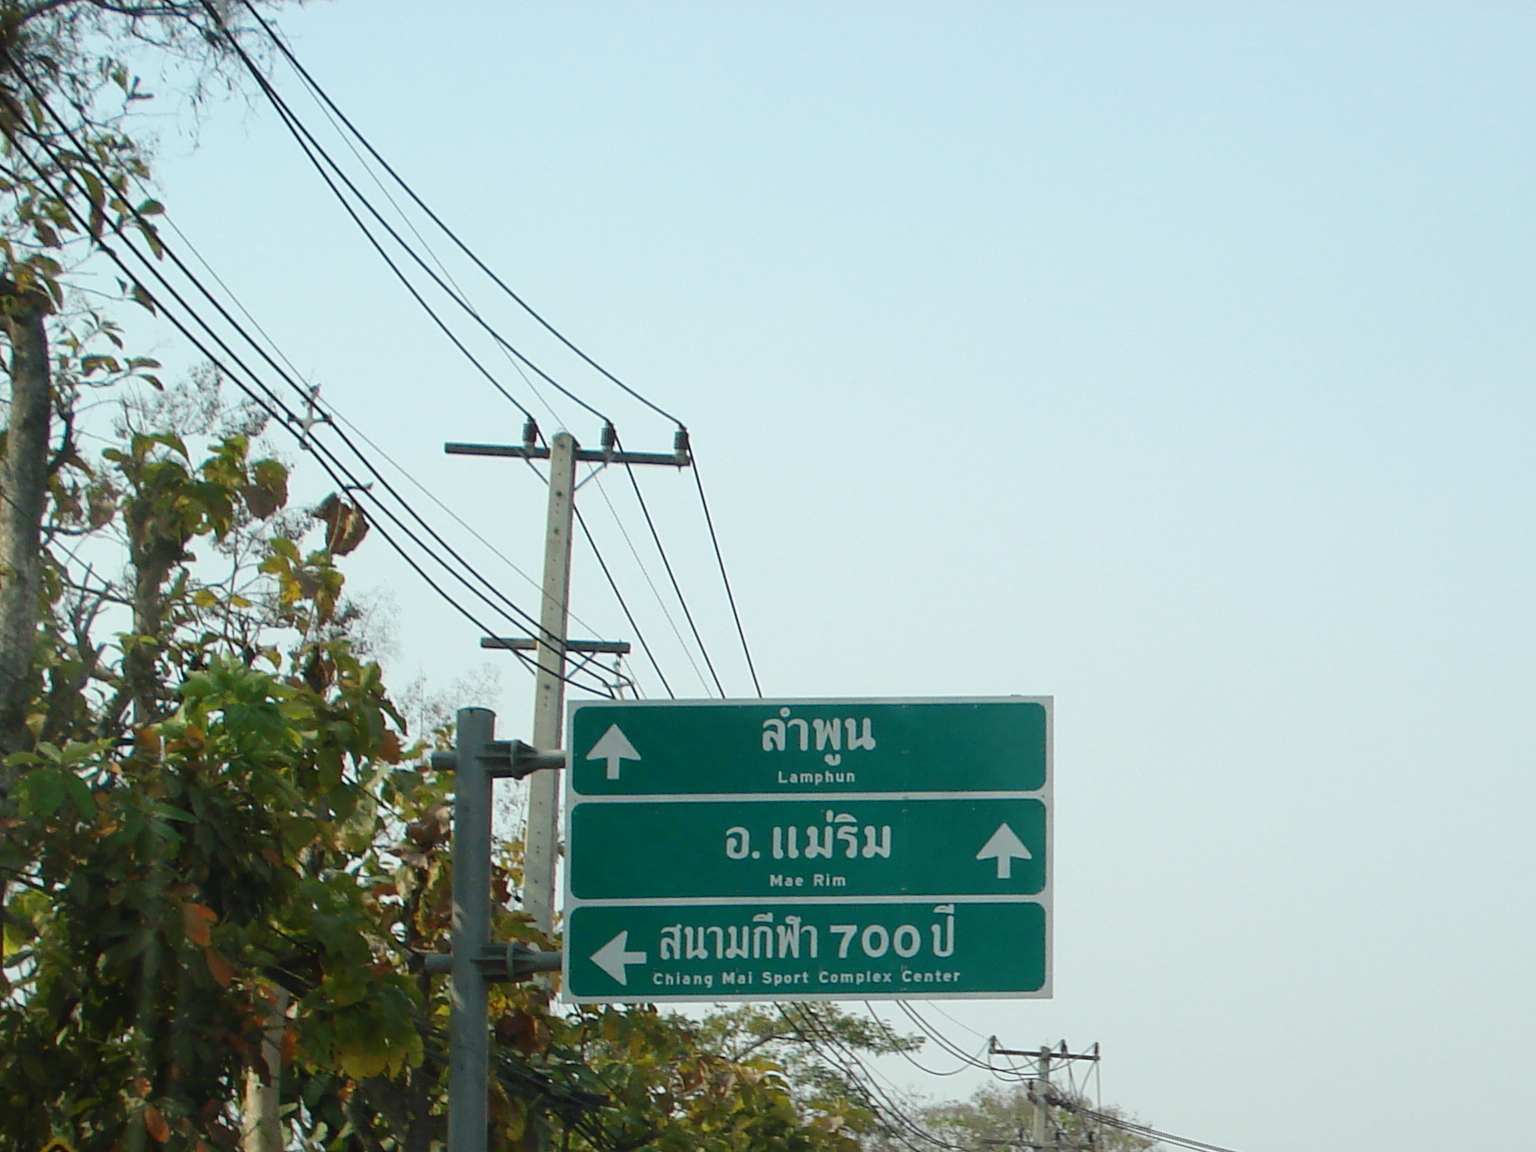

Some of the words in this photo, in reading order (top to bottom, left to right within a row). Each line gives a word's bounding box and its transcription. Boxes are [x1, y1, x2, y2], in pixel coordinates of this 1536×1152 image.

[762, 706, 876, 766] ลำพูน
[778, 770, 856, 786] Lamphun
[725, 826, 760, 860] อ.
[772, 809, 891, 860] แม่ริม
[769, 874, 804, 887] Mae
[813, 873, 847, 886] Rim
[660, 912, 818, 960] สนามกีฬา
[829, 924, 921, 959] 700
[930, 903, 955, 957] ปี
[653, 972, 713, 988] Chiang
[722, 972, 753, 985] Mai
[762, 971, 809, 986] Sport
[818, 970, 892, 985] Complex
[901, 970, 961, 983] Center
